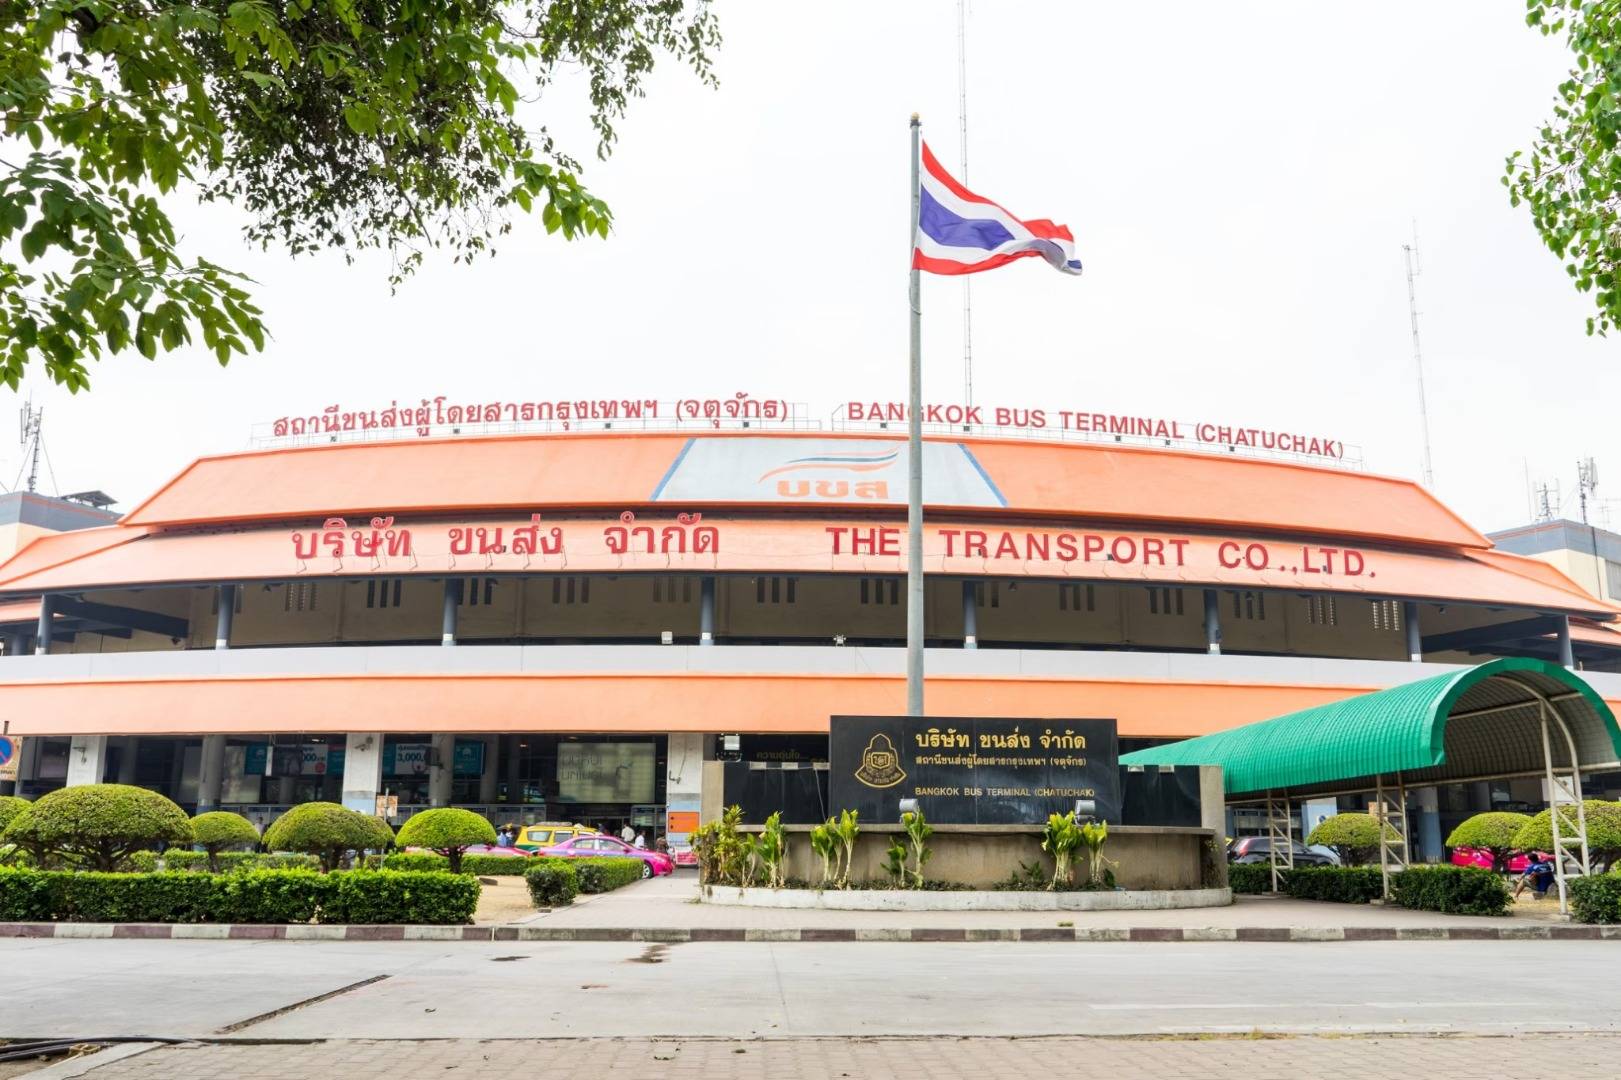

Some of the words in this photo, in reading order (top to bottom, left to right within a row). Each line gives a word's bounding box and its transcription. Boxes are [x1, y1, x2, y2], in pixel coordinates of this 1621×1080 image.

[273, 397, 658, 436] สถานีขนส่งผู้โดยสารกรุงเทพฯ
[676, 392, 788, 429] (จตุจักร)
[995, 407, 1046, 428] BUS
[1059, 411, 1185, 439] TERMINAL
[1195, 422, 1344, 460] (CHATUCHAK)
[292, 516, 412, 560] บริษัท
[449, 513, 563, 556] ขนส่ง
[604, 511, 720, 555] จำกัด
[825, 527, 901, 556] THE
[939, 529, 1190, 567] TRANSPORT
[915, 728, 970, 748] บริษัท
[980, 726, 1031, 748] ขนส่ง
[1039, 729, 1086, 749] จำกัด
[916, 753, 1046, 769] สถานีขนส่งผู้โดยสารกรุงเทพฯ
[1050, 755, 1087, 769] (จตุจักร)
[915, 787, 960, 796] BANGKOK
[963, 787, 983, 796] BUS
[987, 788, 1031, 797] TERMINAL
[1034, 788, 1095, 797] (CHATUCHAK)
